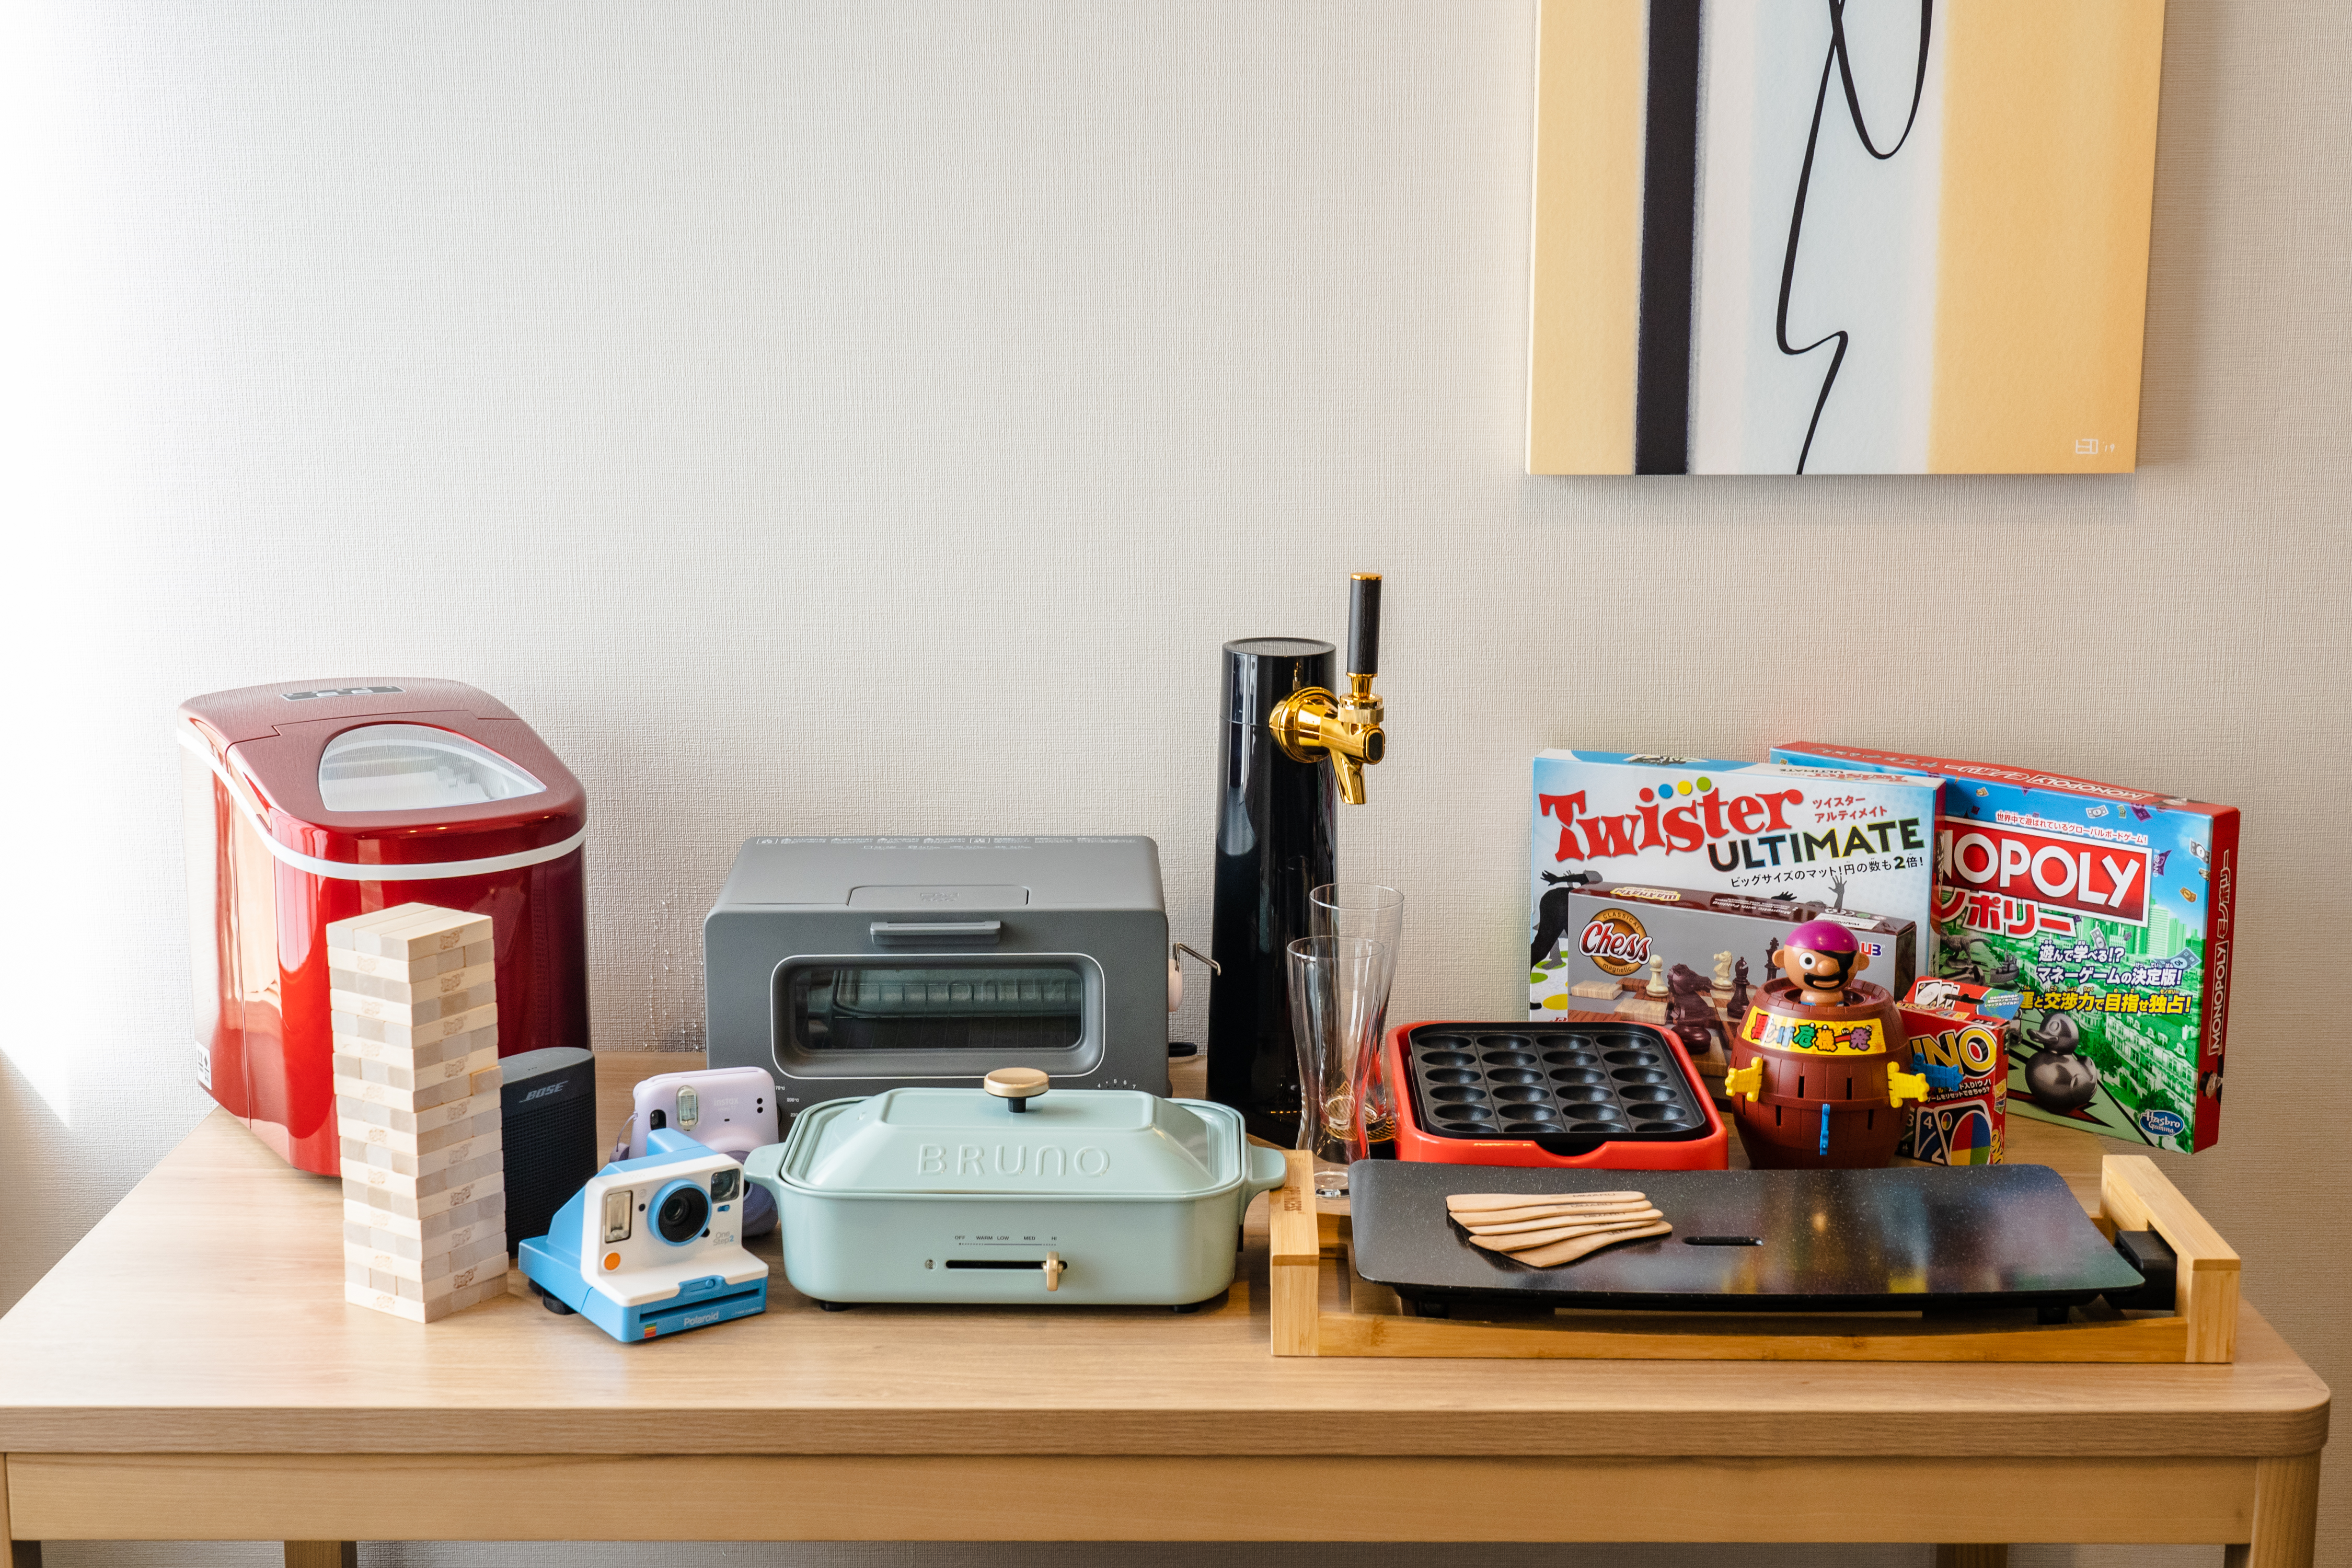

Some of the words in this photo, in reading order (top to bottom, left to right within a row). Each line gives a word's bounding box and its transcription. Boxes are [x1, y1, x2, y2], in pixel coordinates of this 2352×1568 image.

[2031, 776, 2142, 799] MONOPOLY
[1812, 795, 1866, 809] ツイスター
[1814, 805, 1887, 823] アルティメイト
[1539, 787, 1803, 862] Twister
[1707, 817, 1925, 872] ULTIMATE
[1943, 829, 2140, 908] OPOLY
[1602, 912, 1640, 931] CLASSICAL
[1581, 923, 1650, 962] Chess
[1602, 963, 1632, 973] magnetic
[2211, 947, 2226, 1051] MONOPOLY
[519, 1080, 569, 1103] BOSE
[1923, 1115, 1933, 1129] 4
[2142, 1111, 2181, 1128] Hasbro
[2148, 1121, 2174, 1136] Gaming
[918, 1144, 1111, 1177] BRUNO
[716, 1231, 730, 1239] One
[684, 1310, 719, 1327] Polaroid
